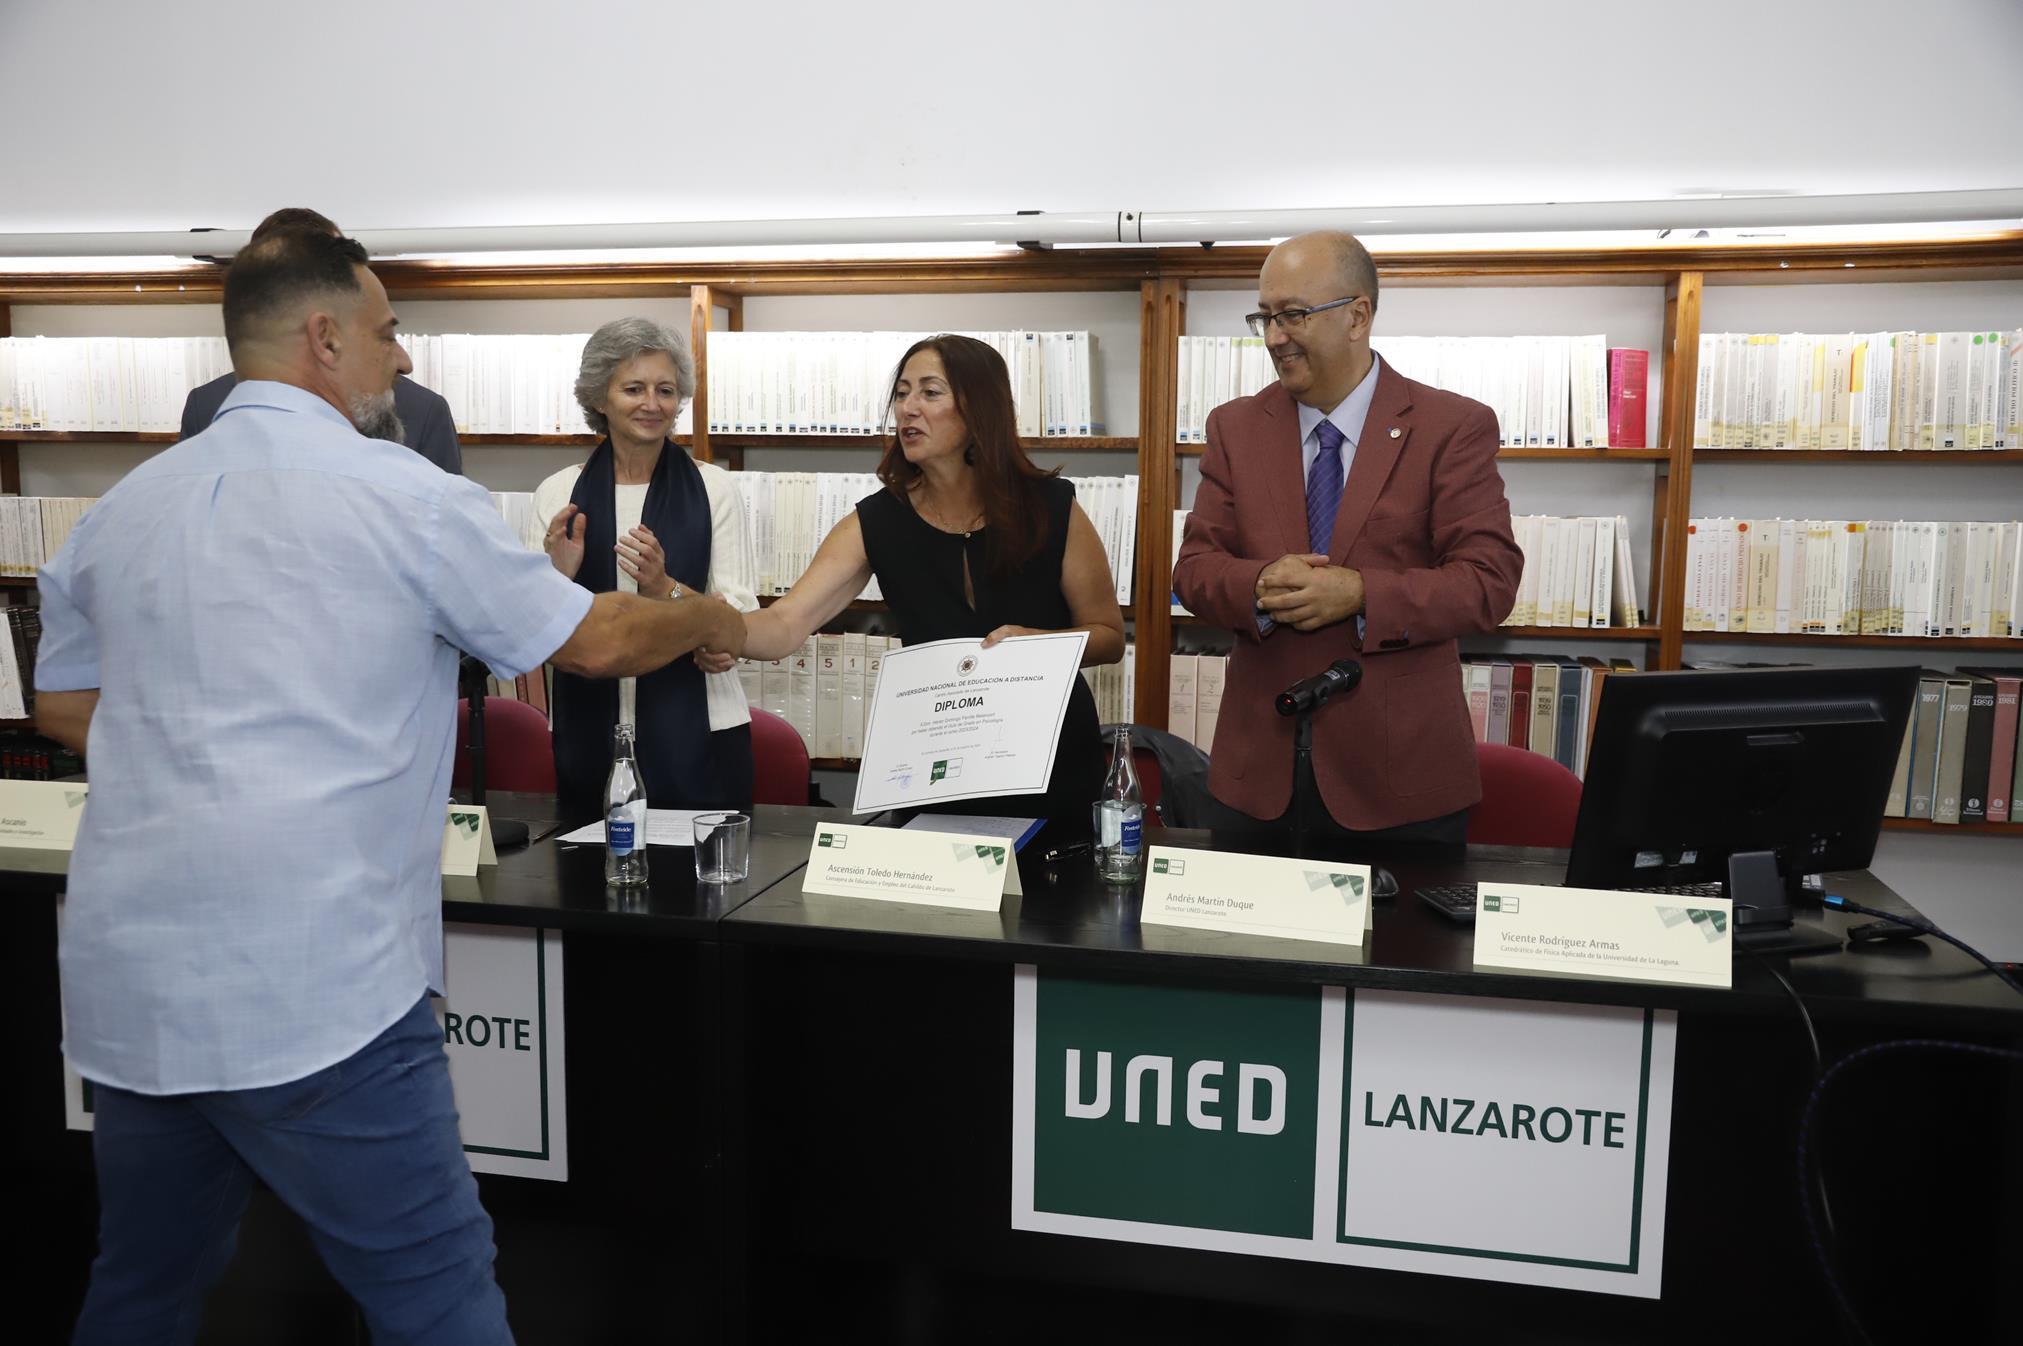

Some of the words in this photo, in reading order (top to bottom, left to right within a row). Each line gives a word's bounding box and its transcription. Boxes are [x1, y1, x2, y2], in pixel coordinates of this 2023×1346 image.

[796, 658, 806, 668] 4
[824, 658, 833, 668] 5
[850, 658, 855, 668] 1
[872, 660, 880, 670] 2
[896, 686, 929, 698] UNIVERSIDAD
[930, 682, 957, 691] NACIONAL
[934, 696, 984, 712] DIPLOMA
[828, 864, 864, 875] Ascensión
[866, 868, 891, 878] Toledo
[894, 871, 933, 881] Hernández
[1166, 893, 1195, 904] Andrés
[1227, 899, 1254, 910] Duque
[1501, 932, 1536, 944] Vicente
[1589, 939, 1620, 950] Armas
[1064, 1048, 1288, 1136] UNED
[1363, 1091, 1625, 1149] LANZAROTE
